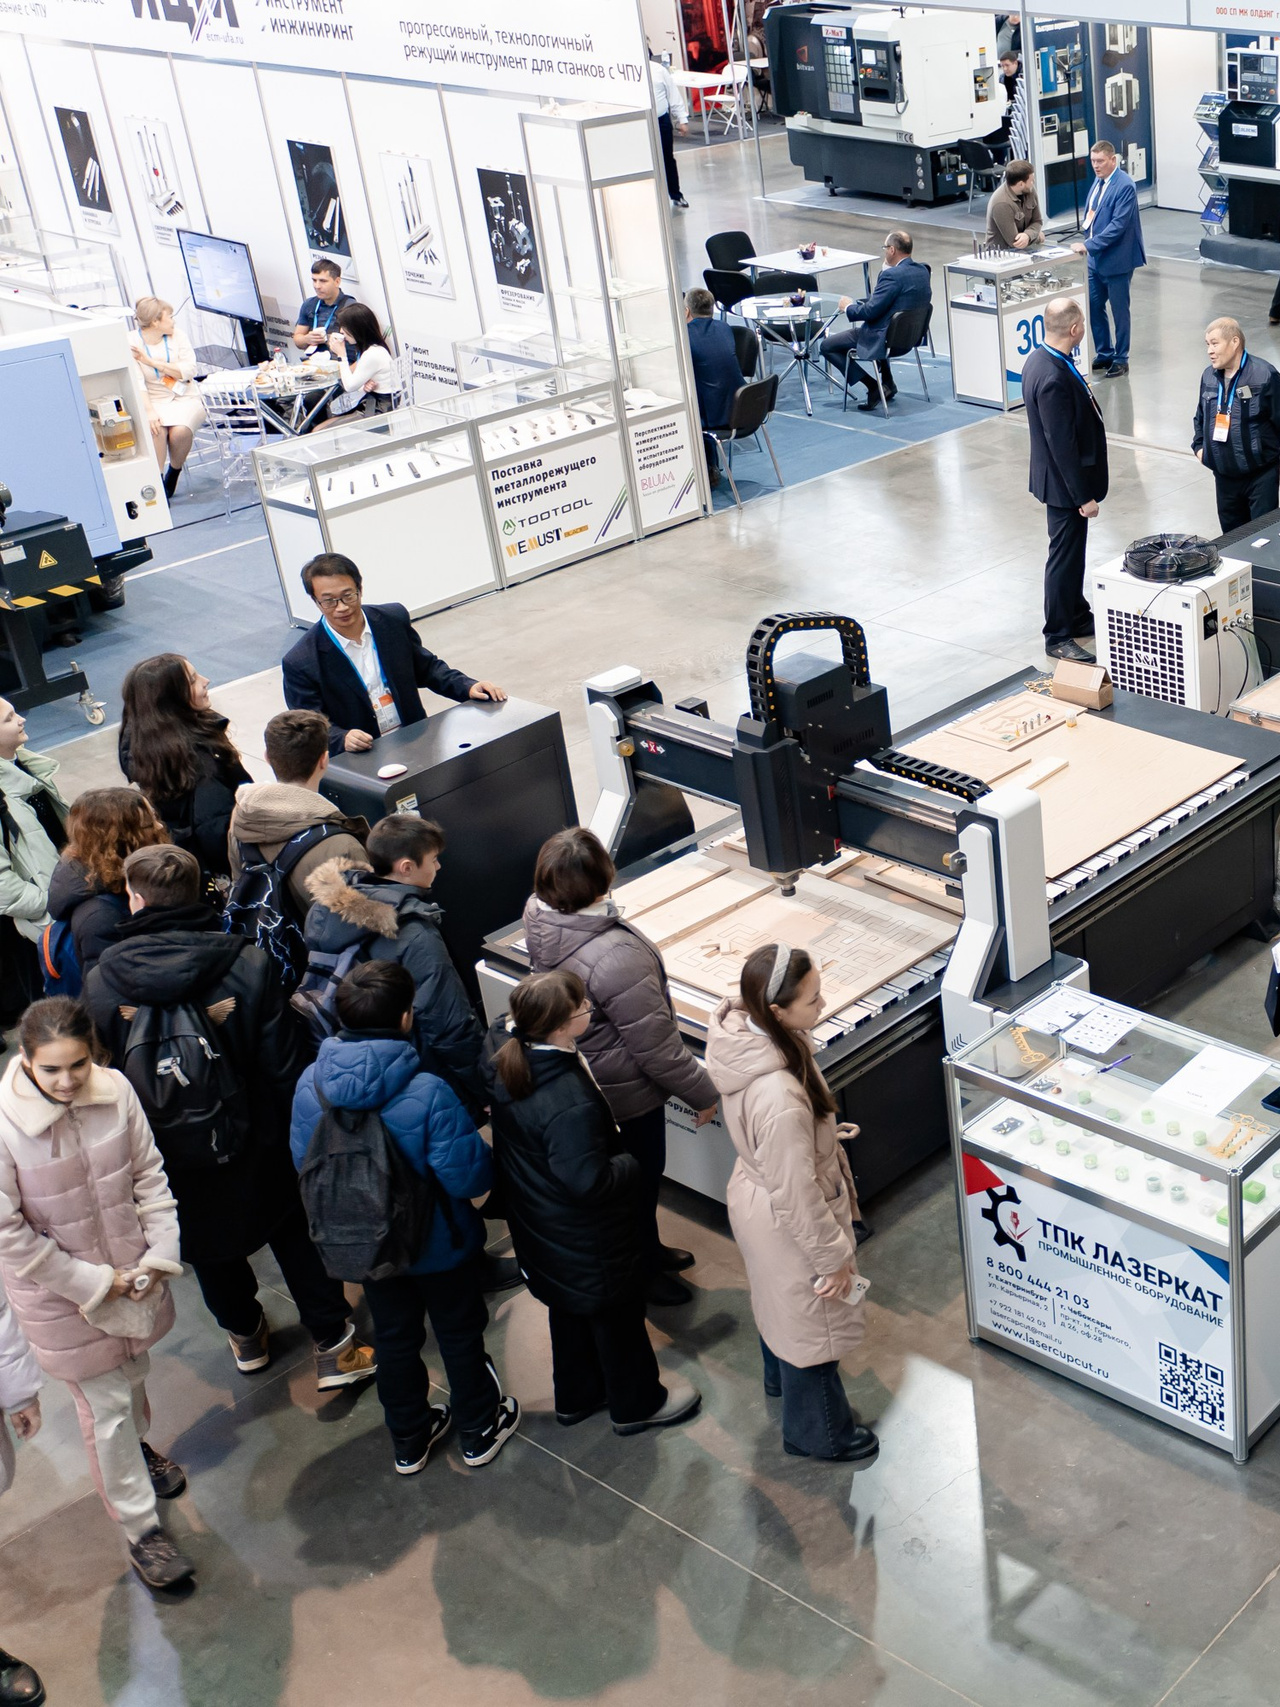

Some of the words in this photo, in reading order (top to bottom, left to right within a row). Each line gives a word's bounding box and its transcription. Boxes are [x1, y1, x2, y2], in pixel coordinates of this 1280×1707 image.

[32, 5, 47, 18] ЧПУ
[1216, 7, 1227, 15] ООО
[1230, 8, 1237, 16] СП
[1250, 10, 1273, 18] ОЛДЭНГ
[206, 32, 244, 44] ecm-ufa.ru
[270, 17, 354, 41] ИНЖИНИРИНГ
[399, 21, 493, 45] прогрессивный,
[495, 30, 594, 52] технологичный
[404, 44, 458, 63] режущий
[461, 51, 528, 71] инструмент
[532, 58, 553, 74] для
[557, 61, 605, 78] станков
[609, 66, 614, 79] с
[617, 64, 642, 82] ЧПУ
[634, 422, 676, 438] Перспективная
[637, 444, 659, 454] техника
[639, 455, 678, 470] оборудование
[491, 458, 543, 481] Поставка
[494, 456, 597, 495] металлорежущего
[497, 479, 567, 509] инструмента
[518, 498, 593, 528] TOOTOOL
[1135, 653, 1158, 667] S&A
[1037, 1217, 1086, 1255] ТПК
[1093, 1243, 1223, 1312] ЛАЗЕРКАТ
[987, 1257, 994, 1268] 8
[998, 1261, 1023, 1280] 800
[1027, 1275, 1052, 1292] 444
[1055, 1287, 1069, 1300] 21
[1073, 1294, 1090, 1309] 03
[988, 1281, 998, 1289] ул.
[1000, 1286, 1042, 1309] Карьерная,
[995, 1275, 1048, 1302] Екатеринбург
[1038, 1241, 1132, 1288] ПРОМЫШЛЕННОЕ
[1135, 1283, 1224, 1328] ОБОРУДОВАНИЕ
[990, 1308, 1062, 1345] lasercapcut@mail.ru
[999, 1301, 1012, 1313] 922
[1014, 1308, 1024, 1318] 181
[1026, 1314, 1035, 1324] 42
[1037, 1319, 1047, 1328] 03
[1068, 1306, 1112, 1331] Чебоксары
[1060, 1312, 1082, 1327] пр-кт.
[1094, 1327, 1132, 1349] Горького,
[1067, 1323, 1078, 1334] 26,
[1080, 1329, 1103, 1344] оф.28
[992, 1320, 1109, 1378] www.lasercupcut.ru
